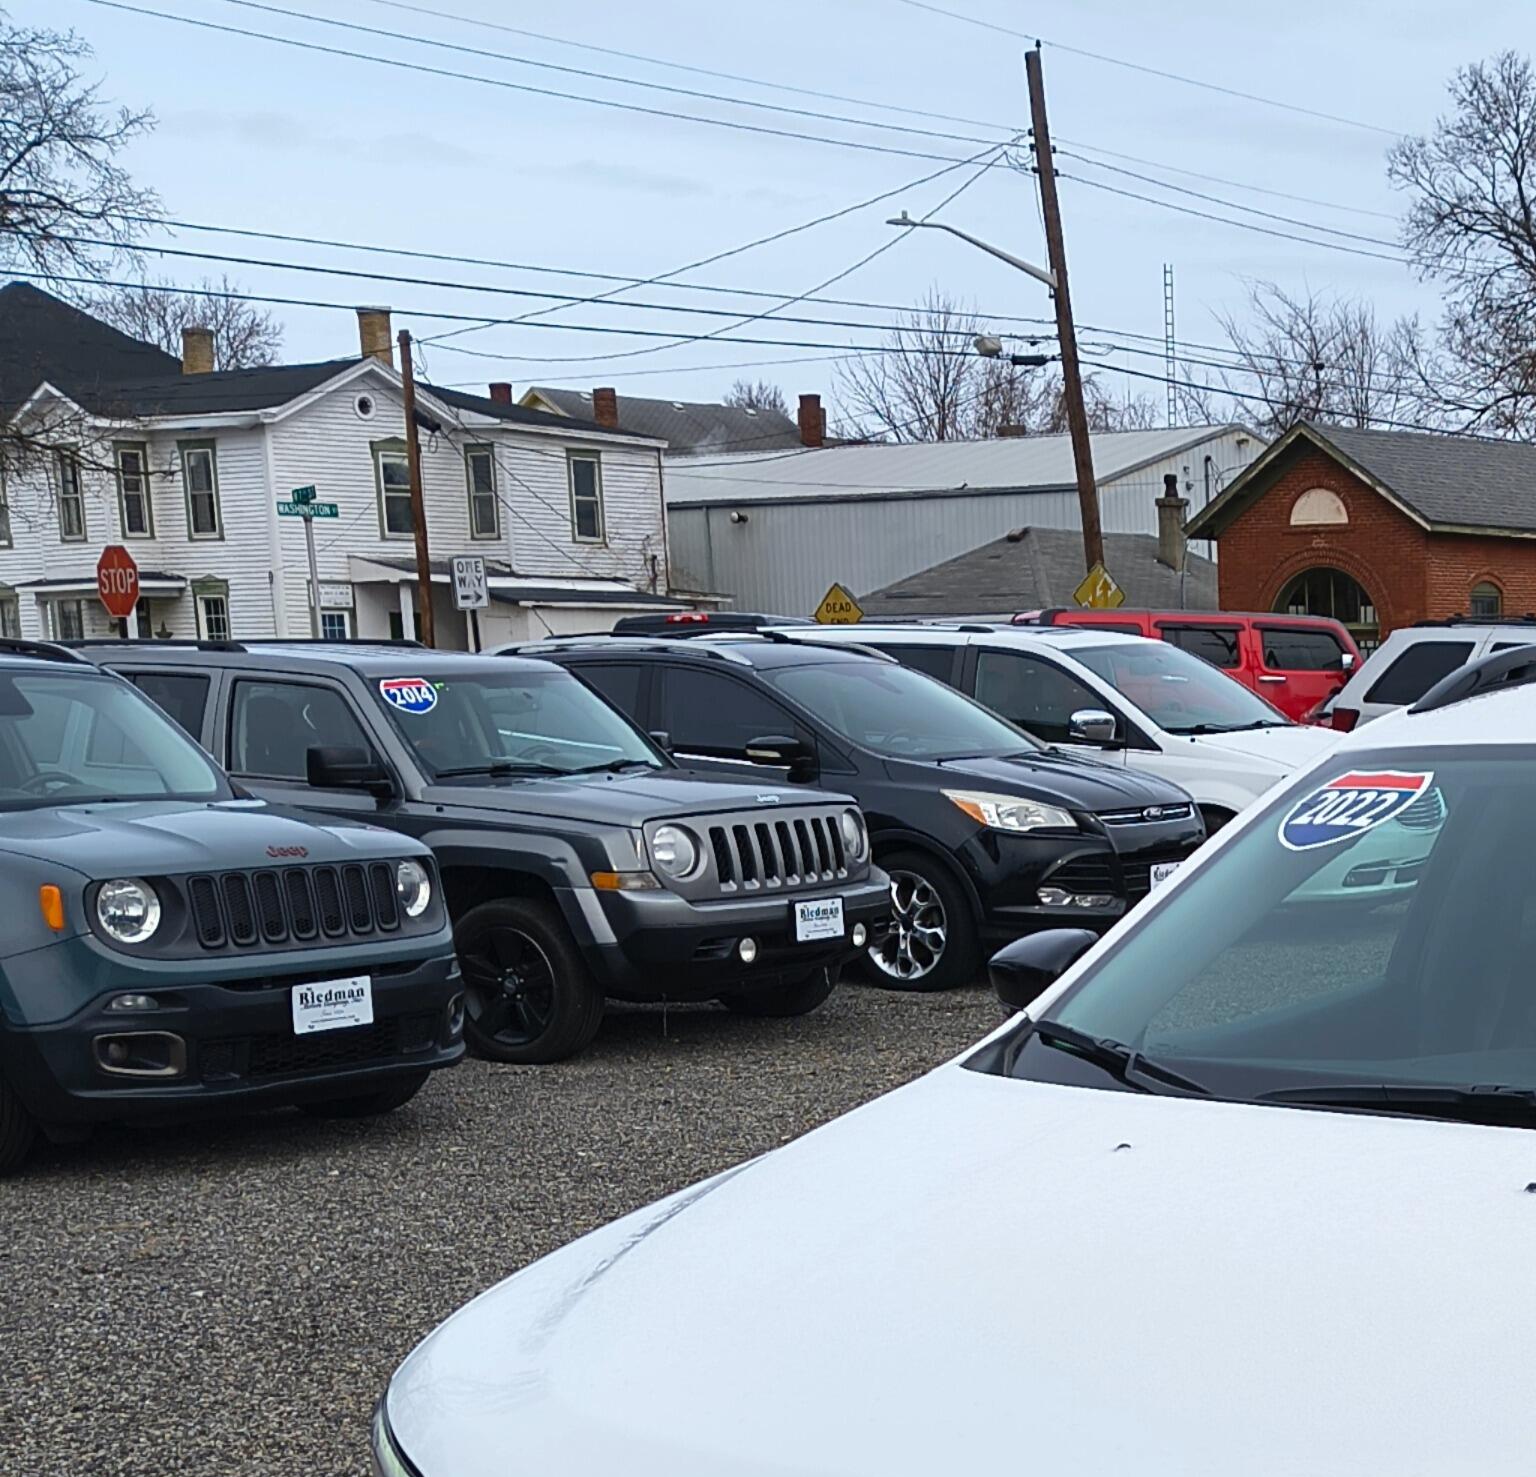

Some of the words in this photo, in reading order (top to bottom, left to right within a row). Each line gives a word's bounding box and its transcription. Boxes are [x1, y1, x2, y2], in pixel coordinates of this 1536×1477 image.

[278, 503, 331, 516] WASHINGTON
[456, 560, 482, 574] ONE
[101, 568, 136, 594] STOP
[457, 575, 482, 588] WAY
[825, 602, 852, 613] DEAD
[389, 686, 434, 705] 2014
[1289, 790, 1400, 827] 2022
[265, 845, 309, 858] Jeep
[299, 987, 365, 1005] Riedman
